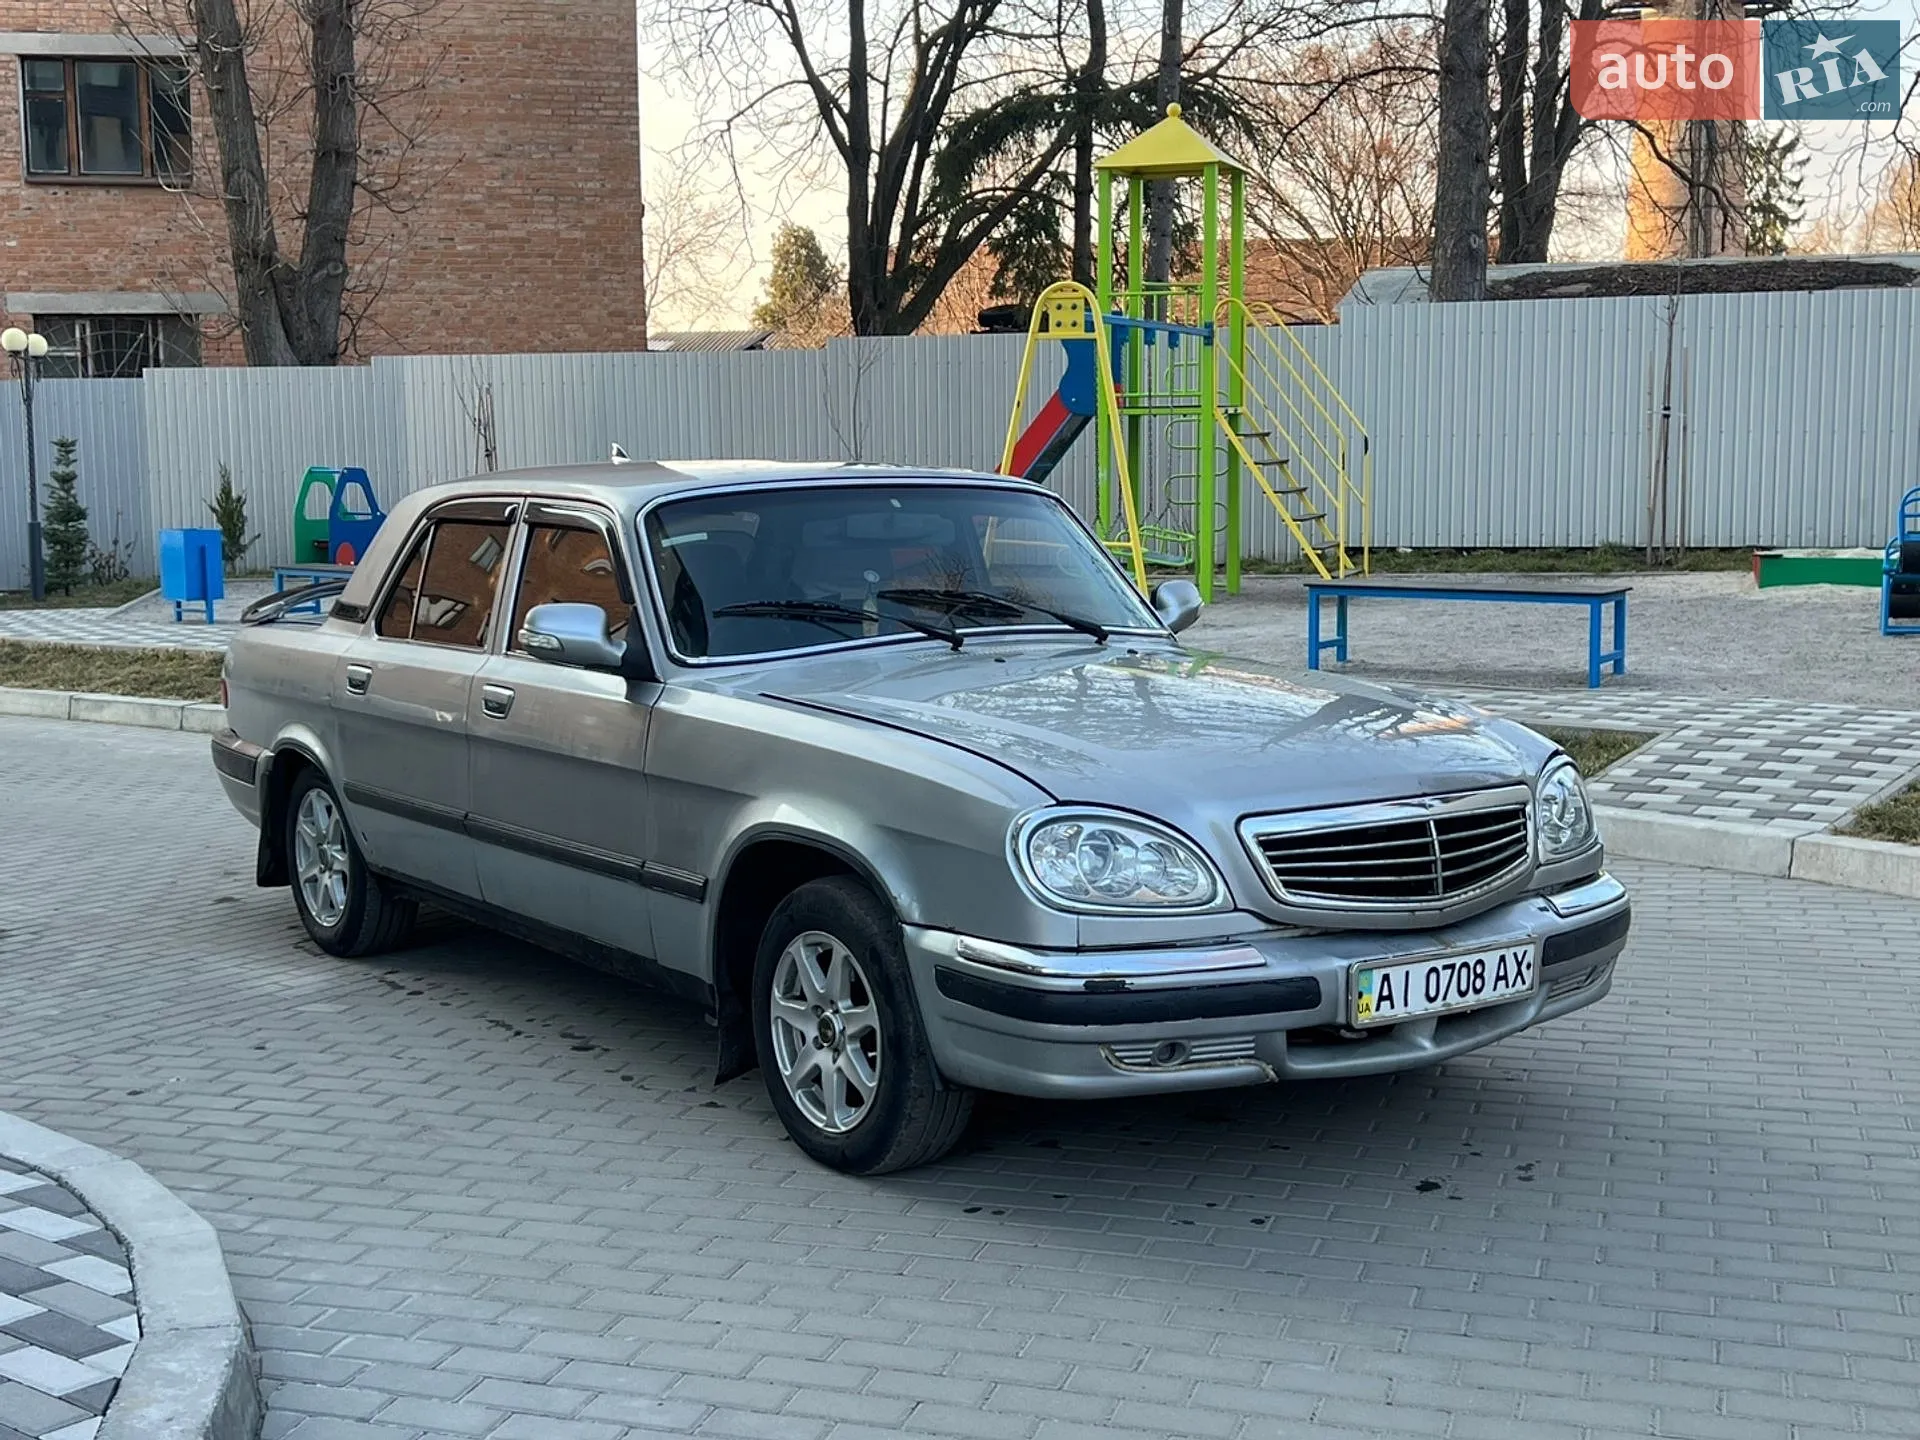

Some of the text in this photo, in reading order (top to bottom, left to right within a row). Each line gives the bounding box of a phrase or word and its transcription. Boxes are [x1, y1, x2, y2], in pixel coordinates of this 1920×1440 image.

[1375, 949, 1528, 1012] AI 0708 AX
[1357, 1003, 1371, 1014] UA
